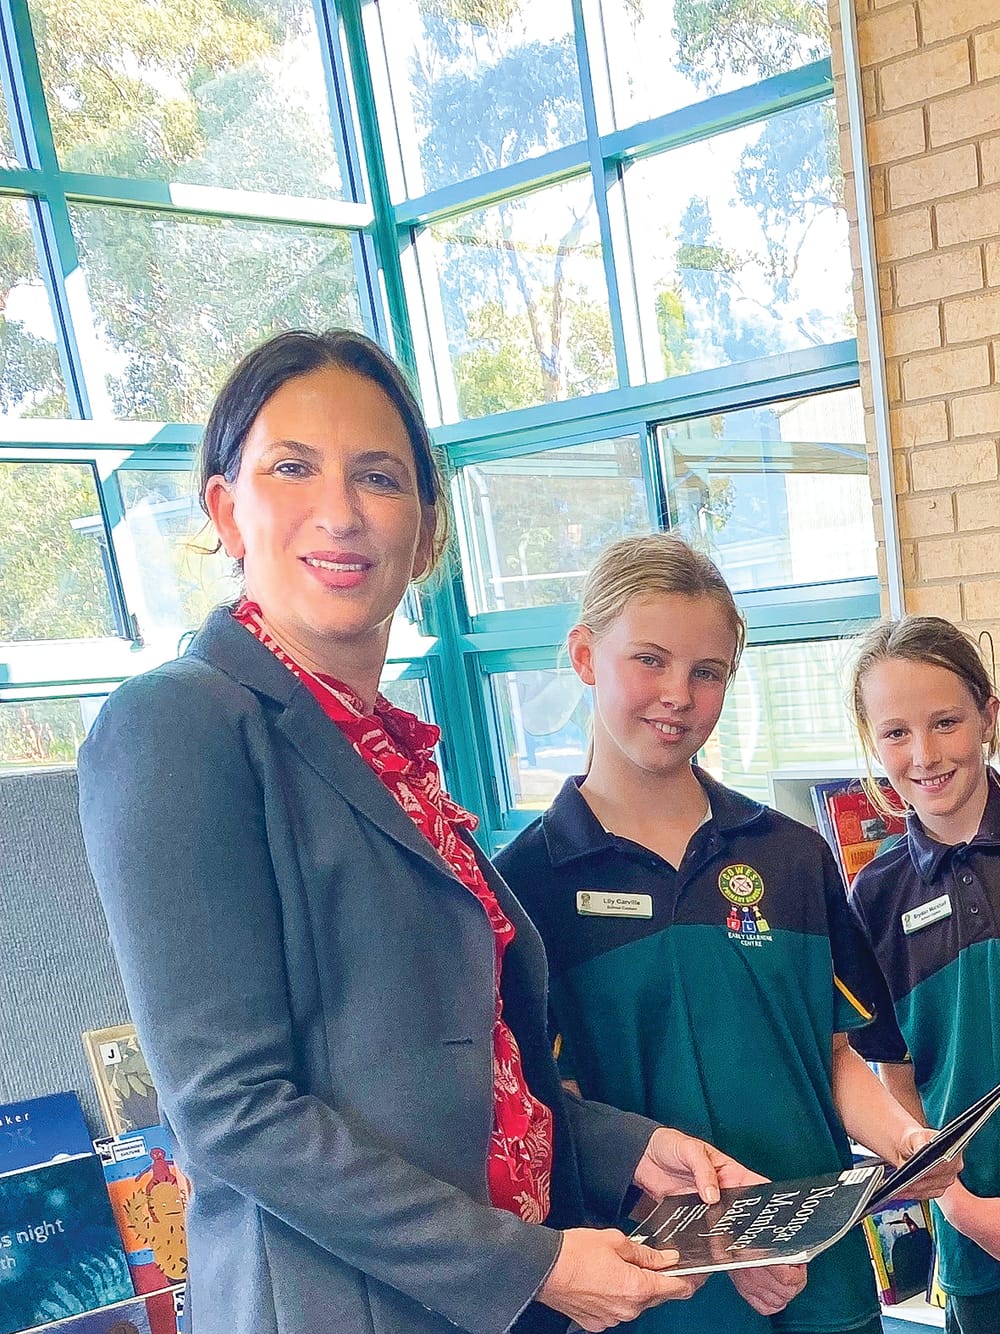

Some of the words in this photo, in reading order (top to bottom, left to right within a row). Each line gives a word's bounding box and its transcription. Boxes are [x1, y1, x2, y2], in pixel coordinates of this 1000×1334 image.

[722, 866, 758, 881] COWES
[108, 1048, 115, 1059] J
[771, 1183, 840, 1243] Noongar
[0, 1234, 13, 1249] s
[16, 1218, 65, 1244] night
